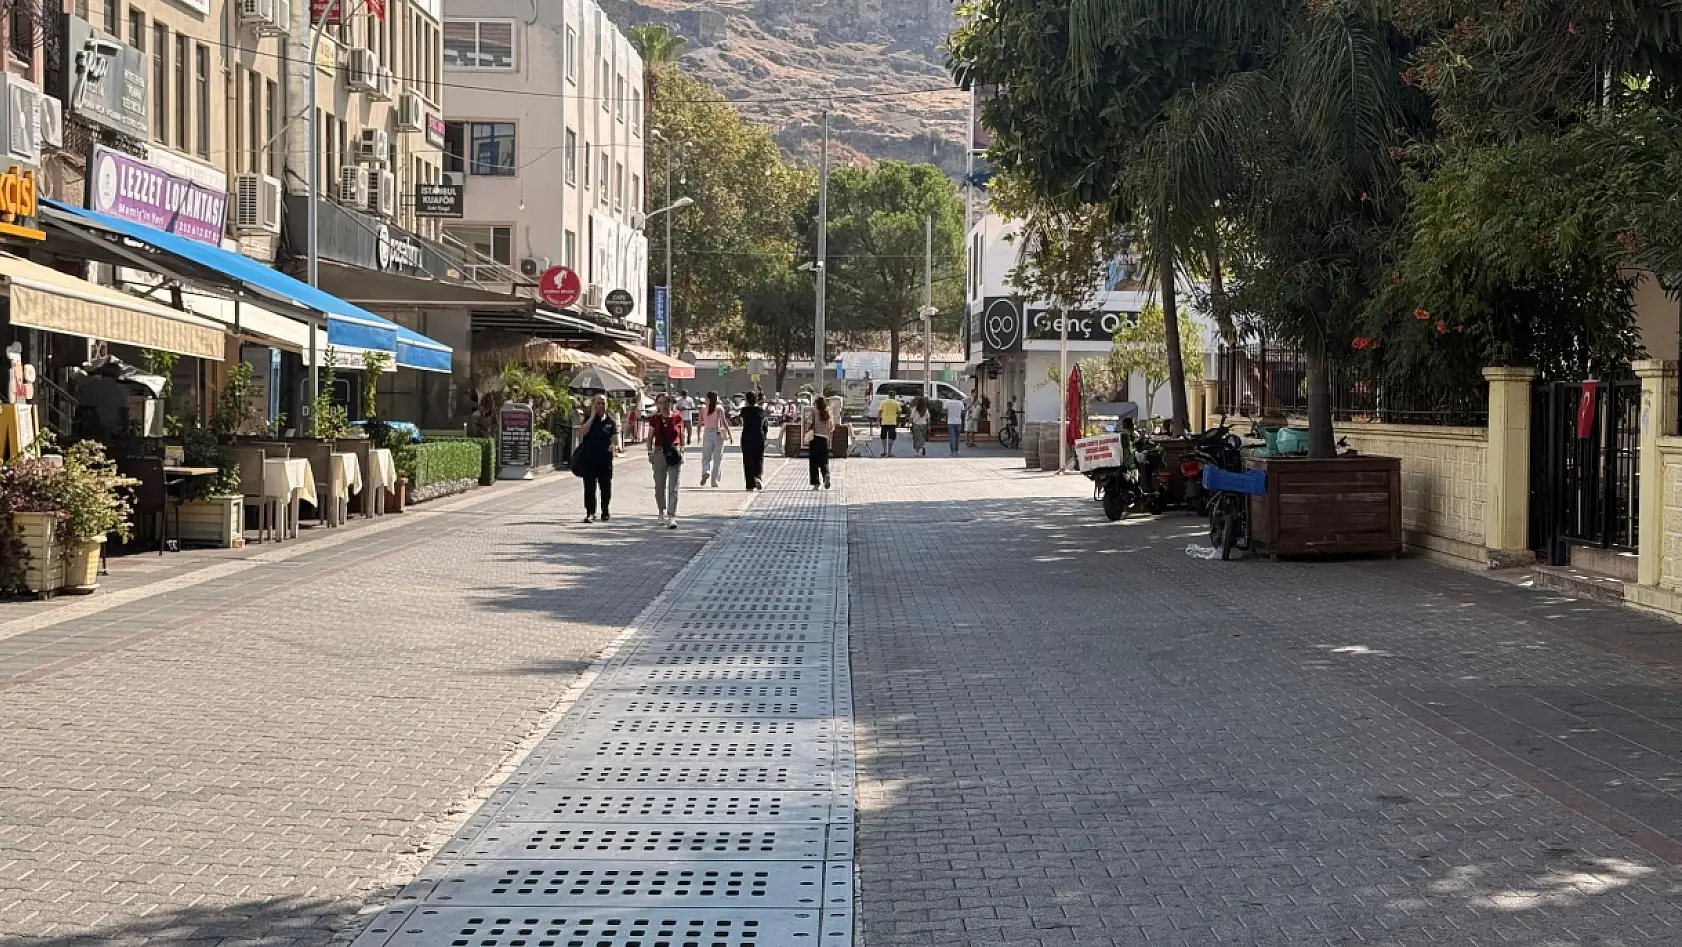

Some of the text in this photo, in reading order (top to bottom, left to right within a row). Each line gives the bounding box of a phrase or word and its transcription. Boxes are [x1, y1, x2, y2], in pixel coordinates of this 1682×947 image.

[120, 164, 163, 207] LEZZET
[165, 180, 225, 229] LOKANTASI
[1033, 311, 1092, 338] Genç
